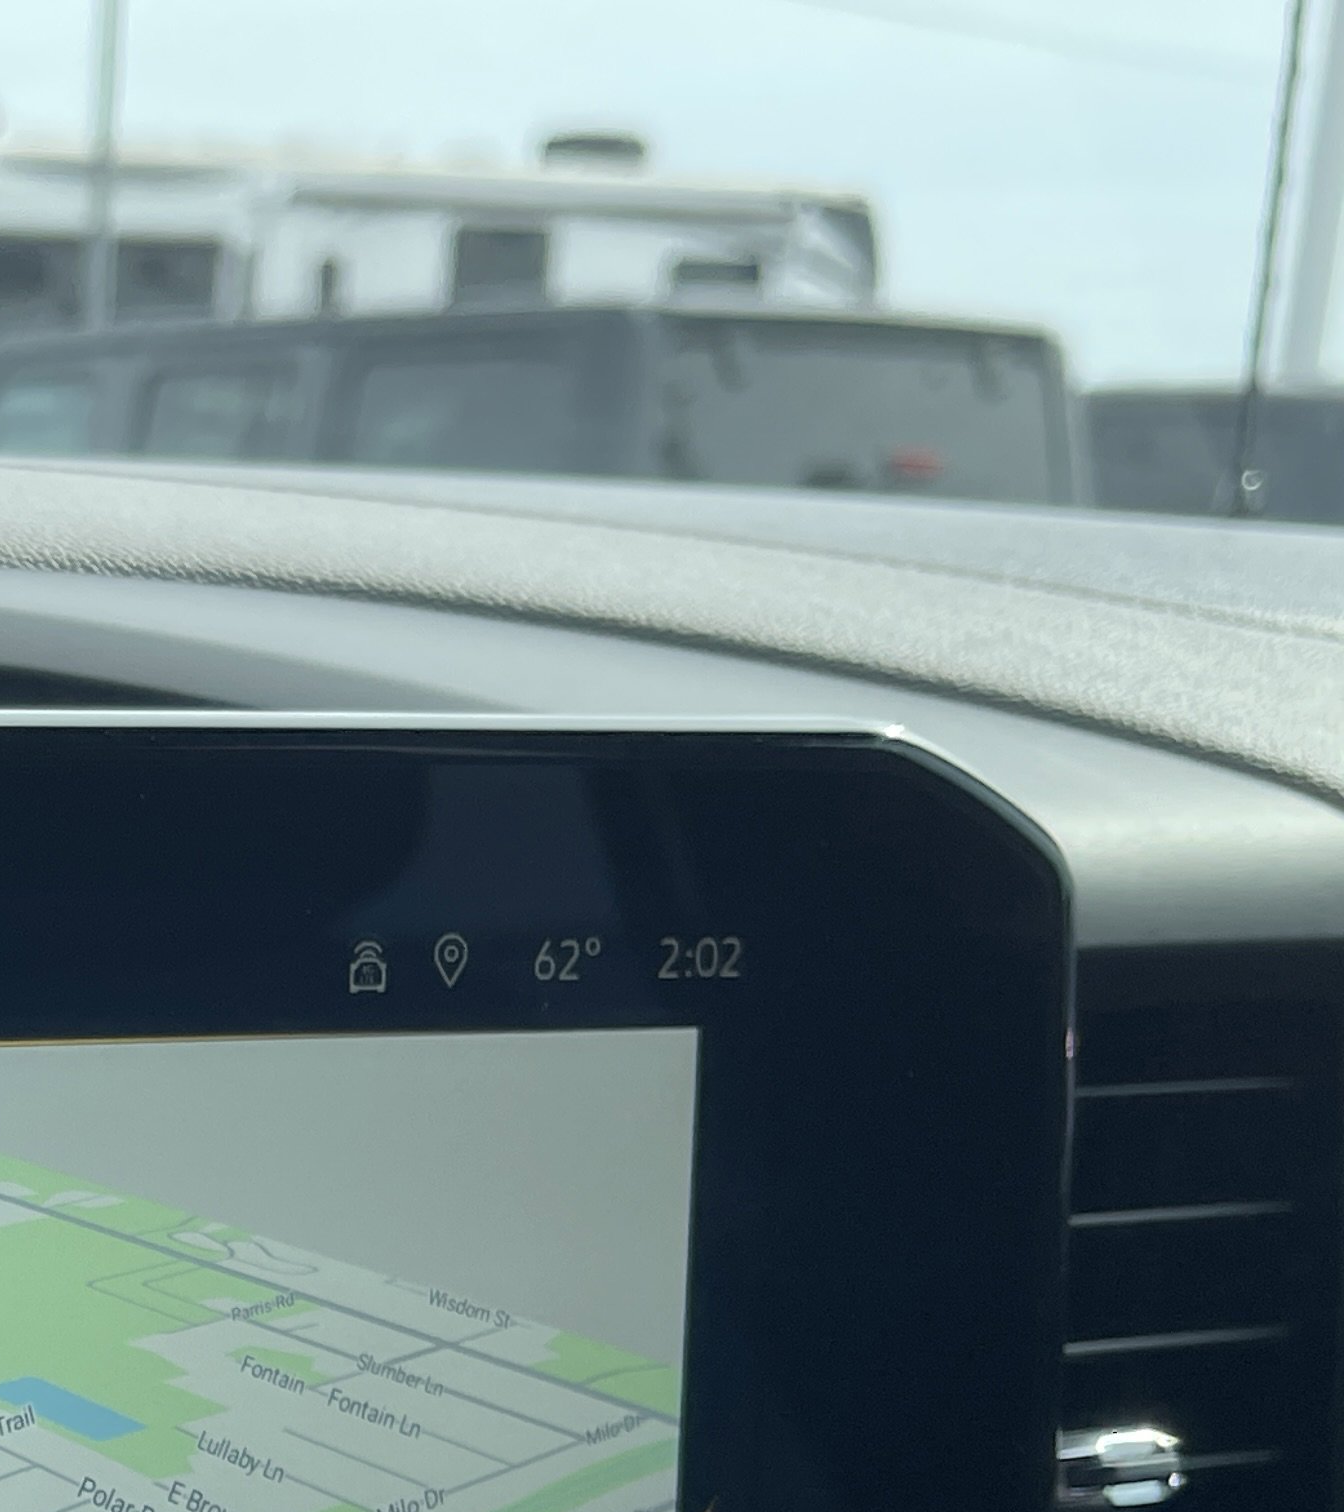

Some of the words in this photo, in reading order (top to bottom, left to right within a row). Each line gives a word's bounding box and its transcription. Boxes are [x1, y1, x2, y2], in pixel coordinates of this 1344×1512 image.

[657, 936, 742, 980] 2:02
[275, 1292, 296, 1310] Rd
[429, 1288, 490, 1323] Wisdom
[494, 1309, 511, 1330] St
[240, 1354, 306, 1396] Fontain
[357, 1353, 424, 1389] Slumber
[424, 1375, 444, 1397] Ln
[327, 1387, 396, 1430] Fontain
[398, 1413, 422, 1439] Ln
[585, 1421, 622, 1446] Milo
[623, 1414, 643, 1433] Dr
[197, 1430, 261, 1477] Lullaby
[262, 1458, 285, 1484] Ln
[167, 1480, 187, 1506] E
[424, 1487, 447, 1511] Dr
